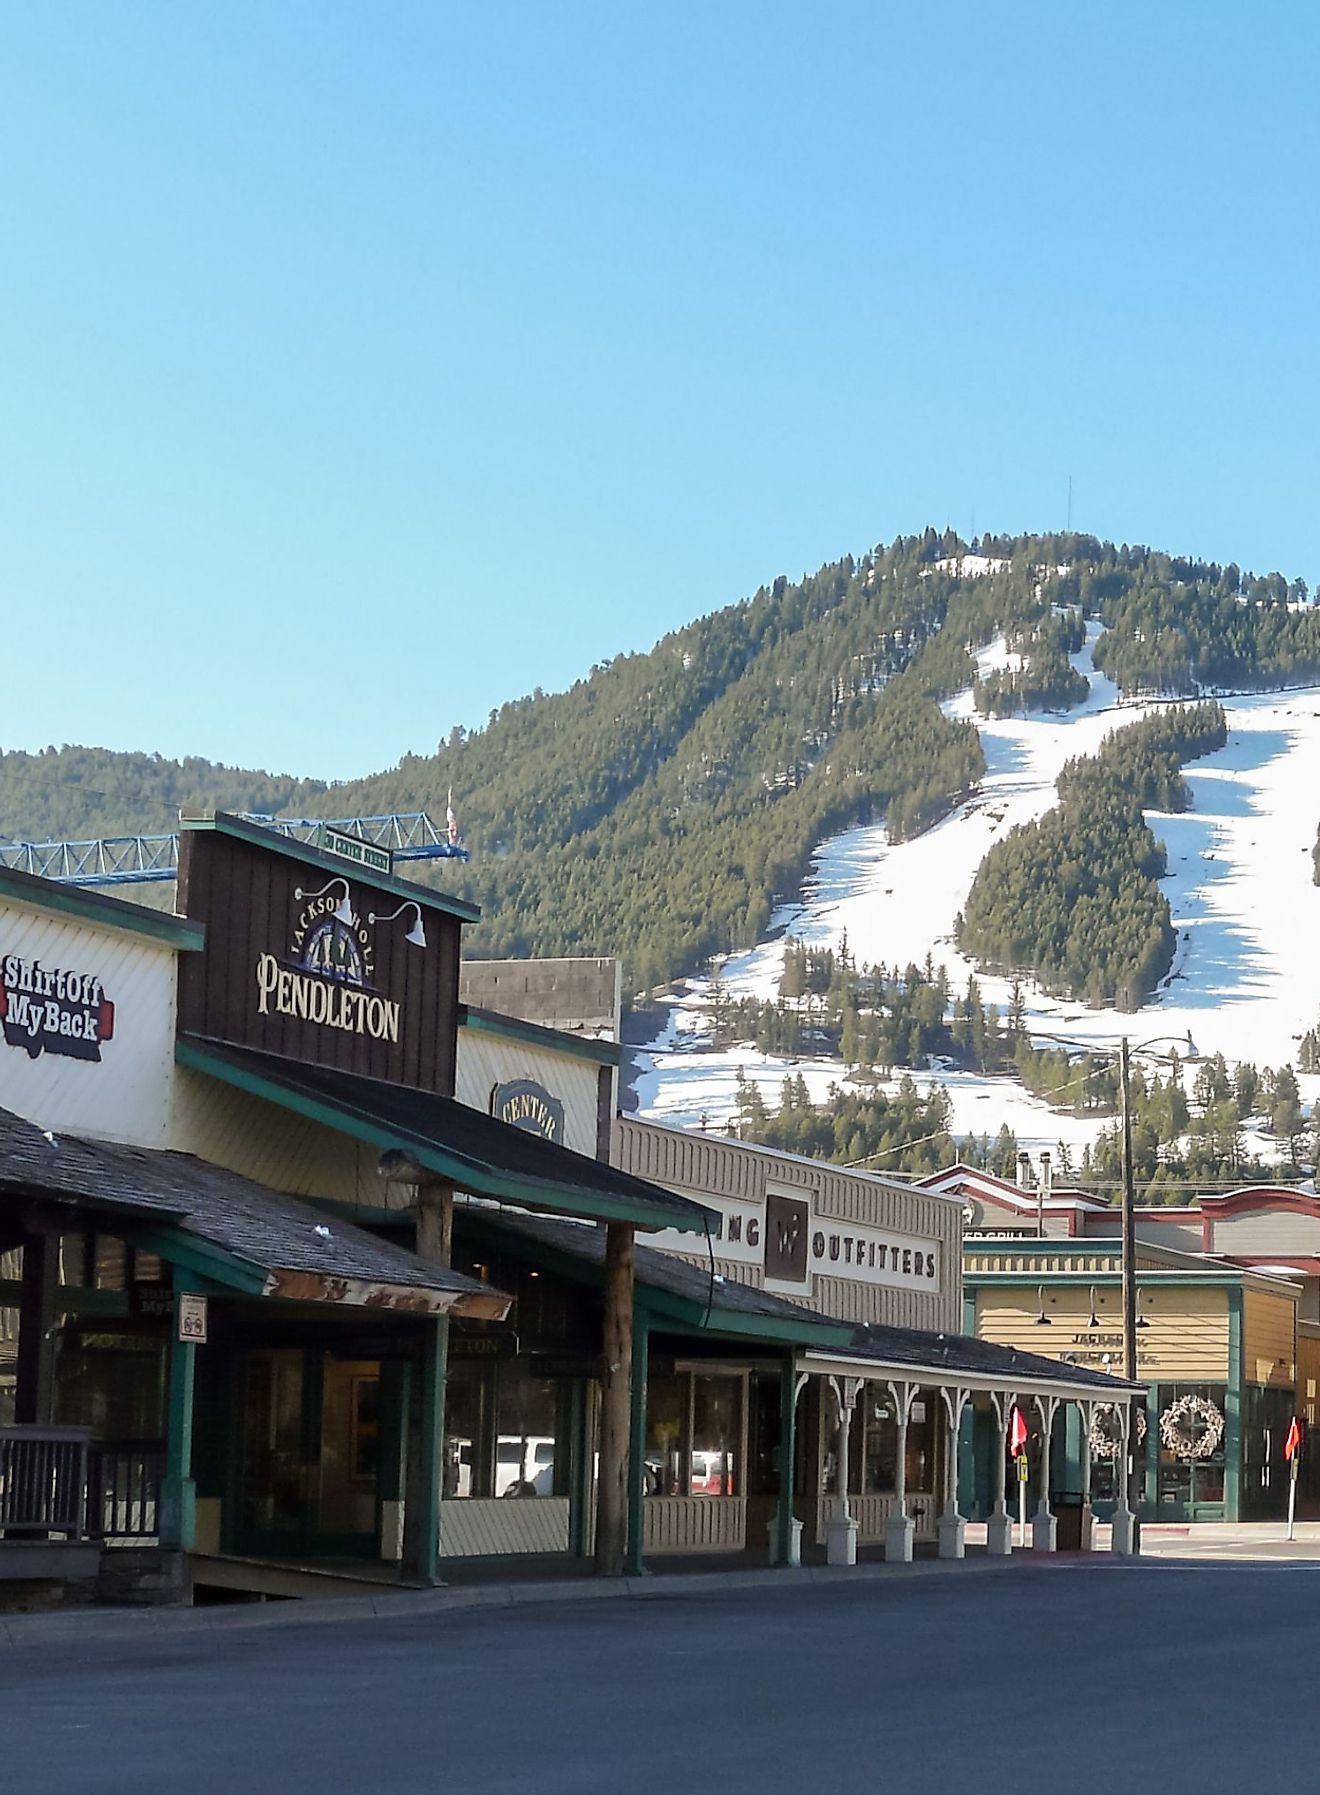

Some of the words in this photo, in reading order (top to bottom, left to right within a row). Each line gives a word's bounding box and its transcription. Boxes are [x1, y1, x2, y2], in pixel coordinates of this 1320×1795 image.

[256, 951, 400, 1043] PENDLETON
[502, 1094, 556, 1139] CENTER
[812, 1231, 935, 1278] OUTFITTERS
